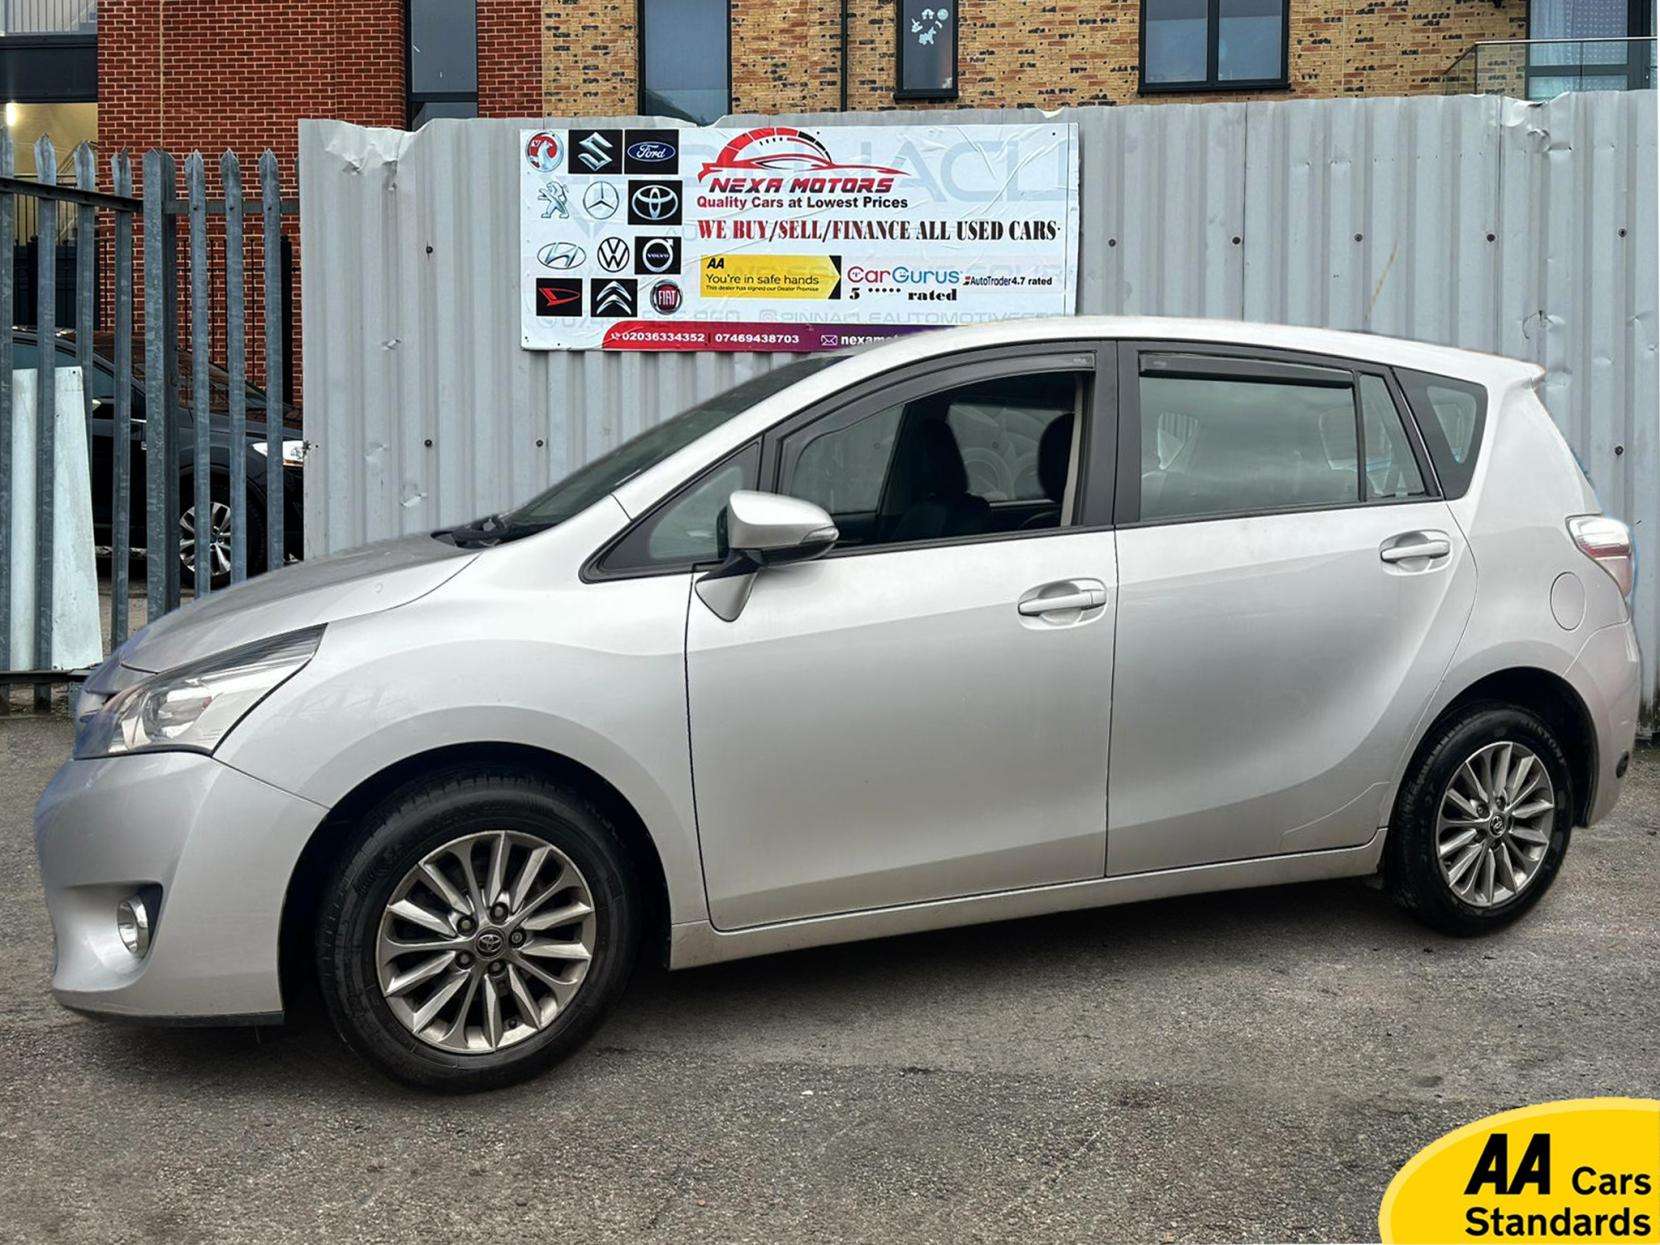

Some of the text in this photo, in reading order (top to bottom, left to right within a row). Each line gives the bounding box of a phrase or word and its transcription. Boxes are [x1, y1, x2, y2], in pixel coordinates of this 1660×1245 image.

[637, 144, 666, 158] Ford
[709, 178, 895, 193] NEXA MOTORS
[697, 196, 909, 210] Quality Cars at Lowest Prices
[696, 220, 727, 240] WE
[732, 219, 911, 242] BUY/SELL/FINANCE
[915, 220, 951, 240] ALL
[956, 220, 1004, 240] USED
[1008, 220, 1057, 240] CARS
[707, 257, 725, 269] AA
[705, 273, 819, 285] You're in safe hands
[847, 265, 960, 284] CarGurus
[1028, 276, 1053, 286] rated
[658, 289, 676, 305] FIAT
[850, 287, 957, 301] 5 rated
[622, 331, 799, 344] 02036334352 07469438703
